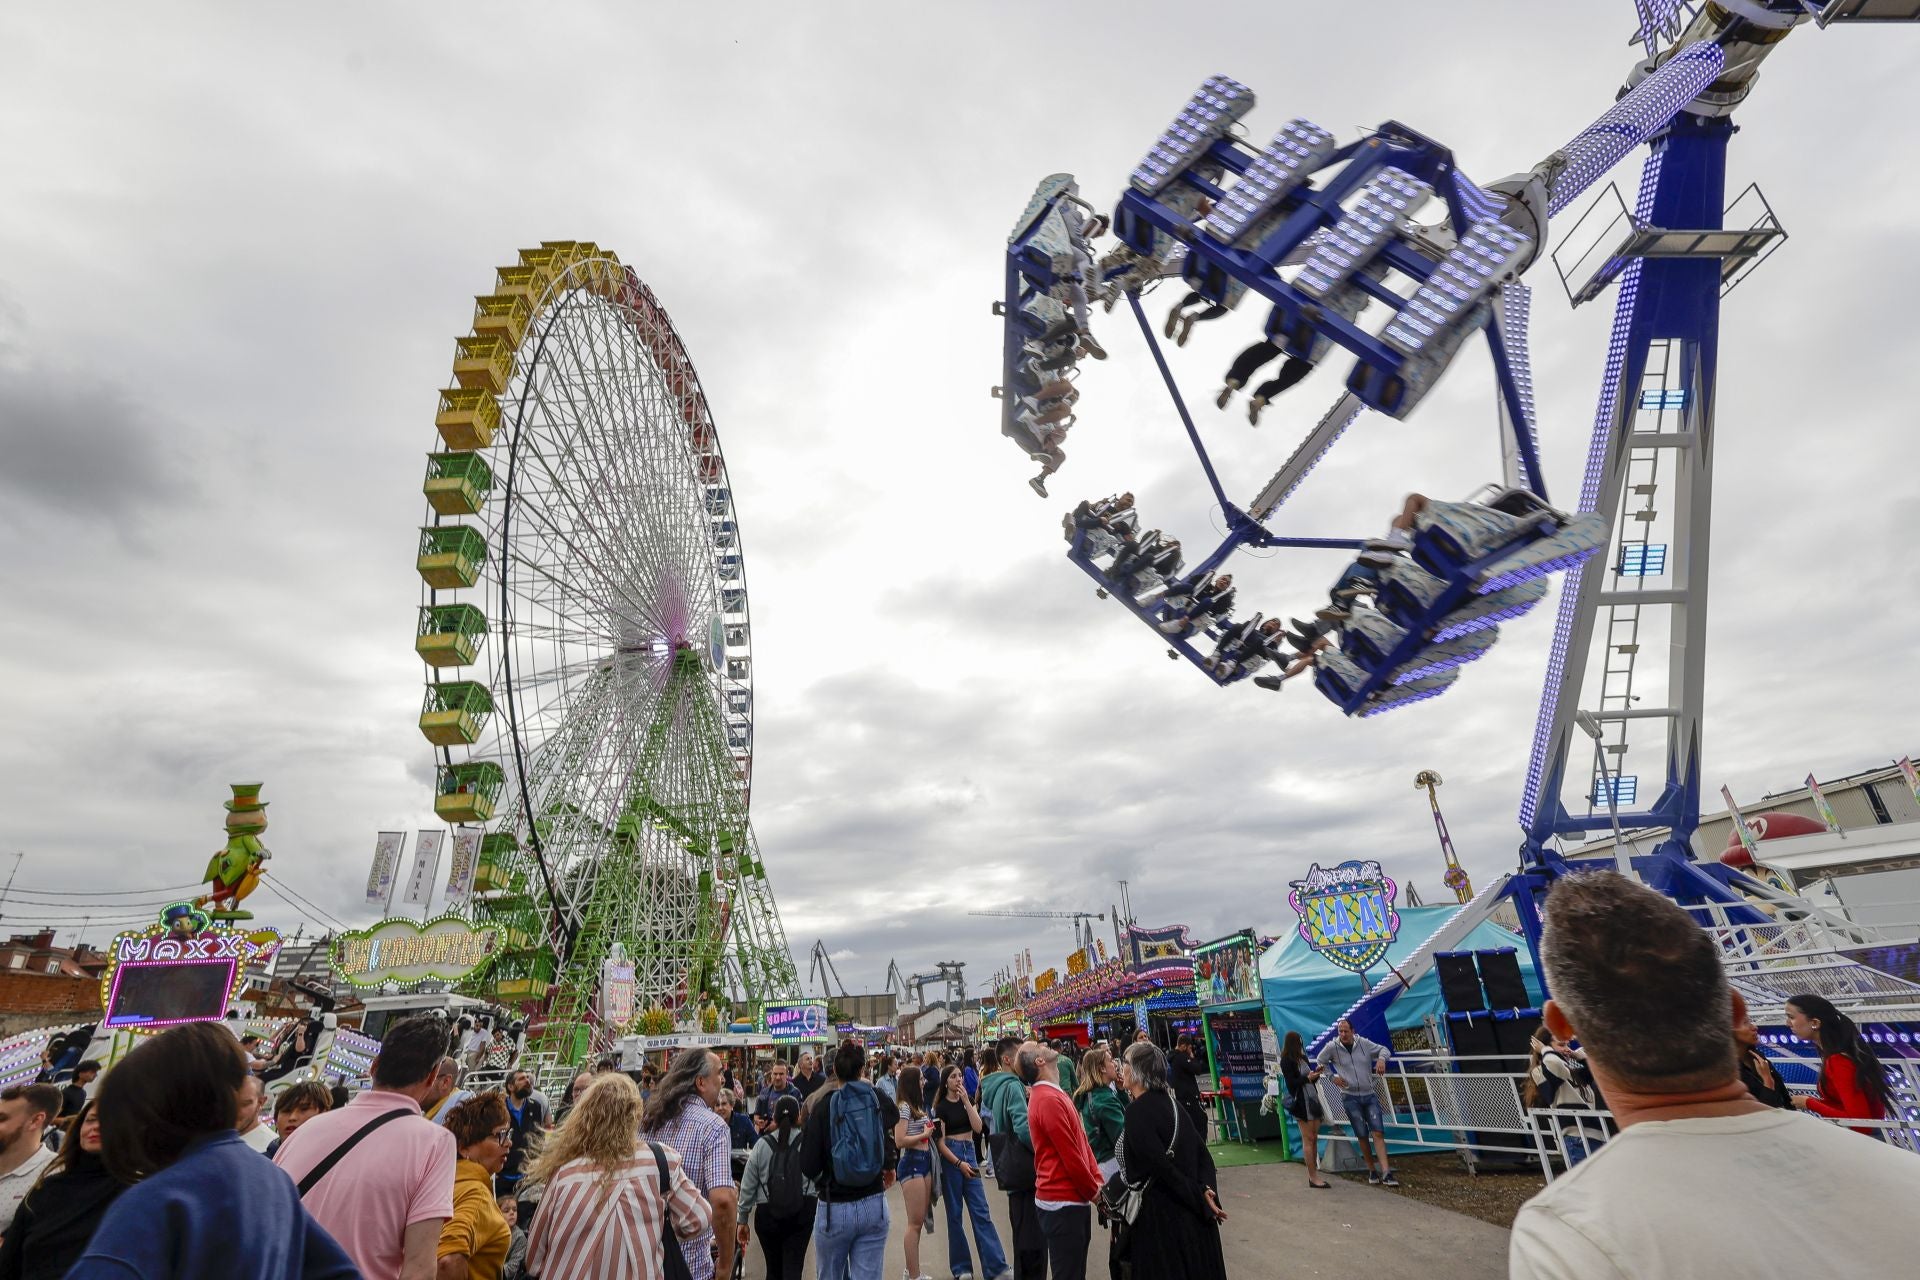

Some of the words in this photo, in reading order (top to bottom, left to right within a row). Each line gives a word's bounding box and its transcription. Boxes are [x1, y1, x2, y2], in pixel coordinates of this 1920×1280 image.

[412, 859, 426, 901] MAXX
[1318, 898, 1355, 938] LA
[118, 934, 243, 962] MAXX
